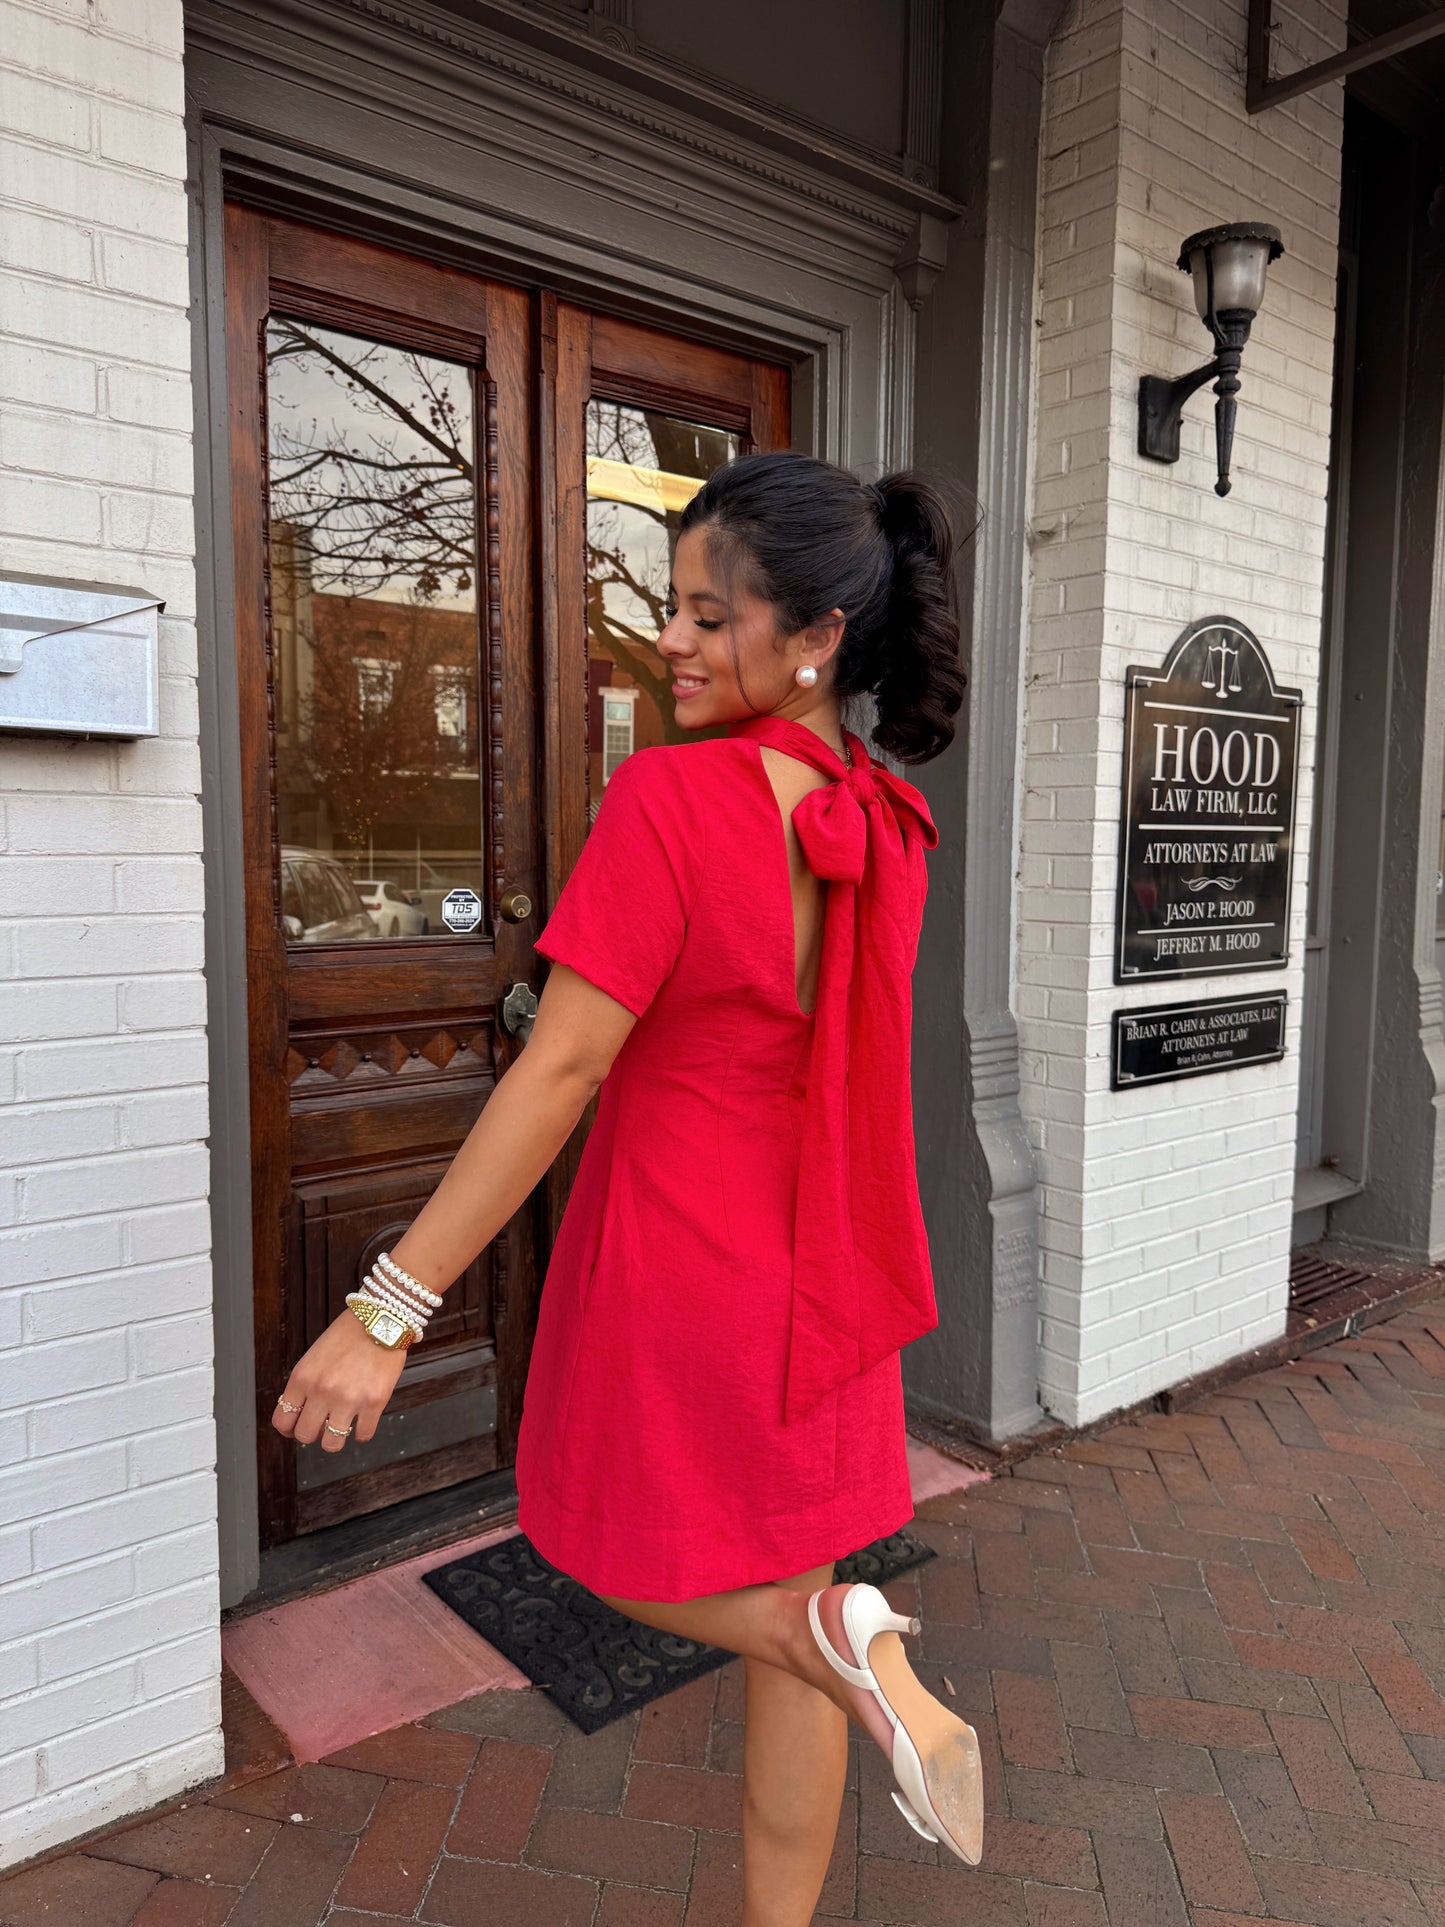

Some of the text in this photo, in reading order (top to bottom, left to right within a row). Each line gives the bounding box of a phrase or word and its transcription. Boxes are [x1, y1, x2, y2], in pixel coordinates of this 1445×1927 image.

[1151, 723, 1280, 787] HOOD
[1151, 788, 1278, 818] LAW FIRM, LLC
[1143, 842, 1278, 864] ATTORNEYS AT LAW
[452, 903, 473, 914] TDS
[1163, 900, 1255, 926] JASON P. HOOD
[1153, 932, 1261, 961] JEFFREY M. HOOD
[1126, 1007, 1277, 1041] BRIAN R. CAHN & ASSOCIATES, LLC
[1160, 1027, 1249, 1054] ATTORNEYS AT LAW
